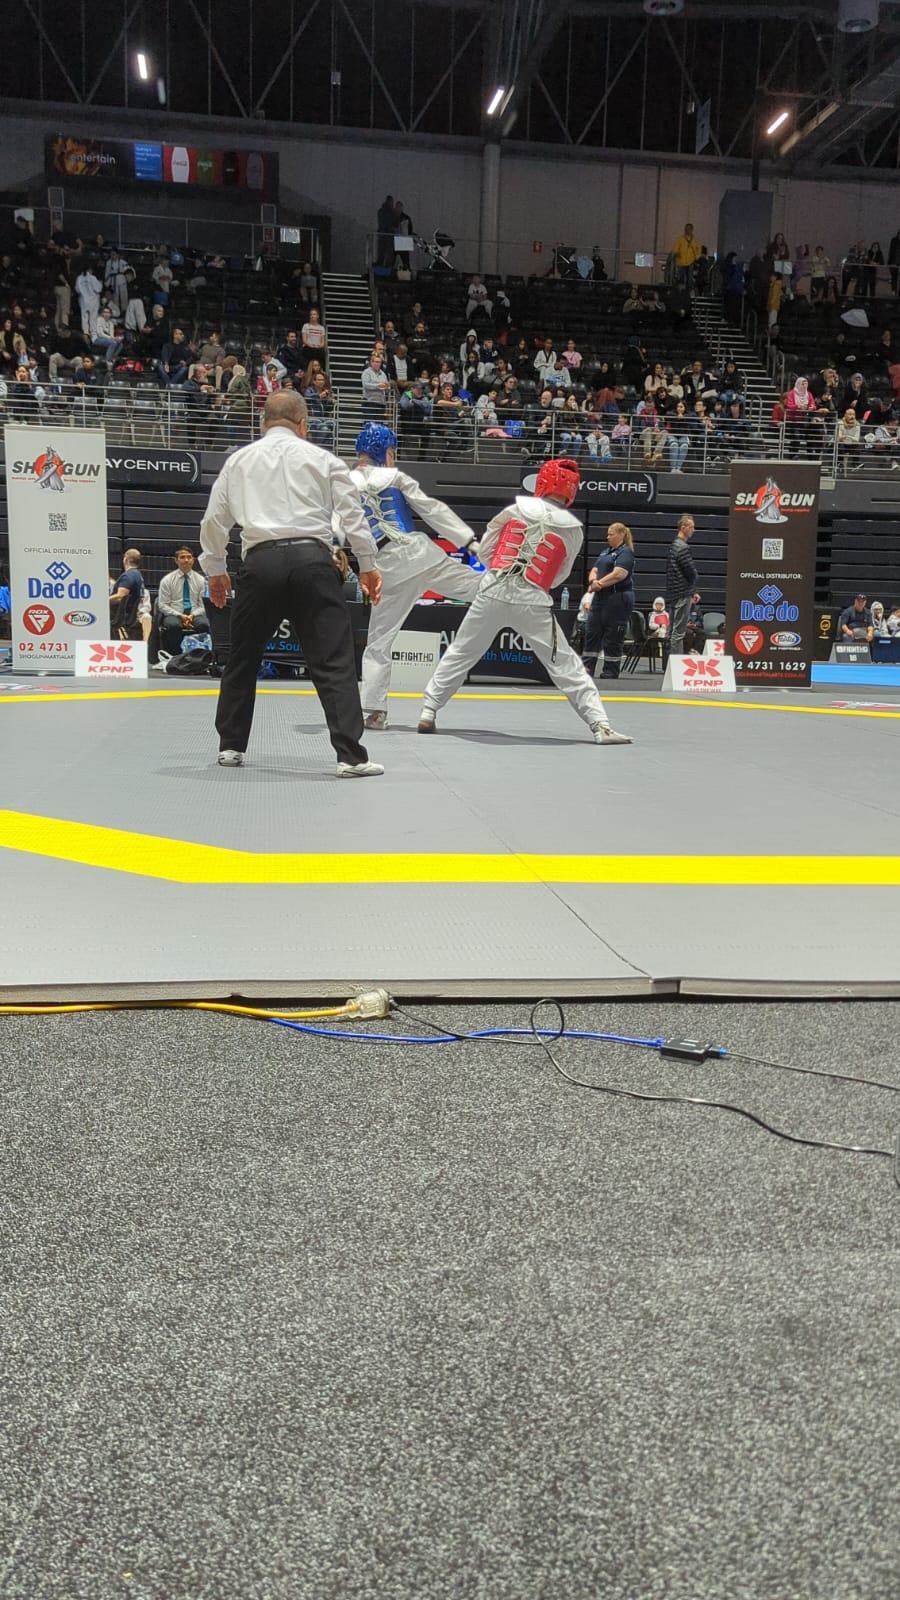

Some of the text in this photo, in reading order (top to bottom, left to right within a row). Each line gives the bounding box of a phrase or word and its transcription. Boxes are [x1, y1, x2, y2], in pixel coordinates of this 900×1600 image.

[19, 642, 68, 652] 02 4731
[501, 651, 535, 664] Wales
[88, 665, 134, 673] KPNP
[747, 661, 773, 670] 4731
[780, 662, 807, 671] 1629
[683, 679, 724, 687] KPNP
